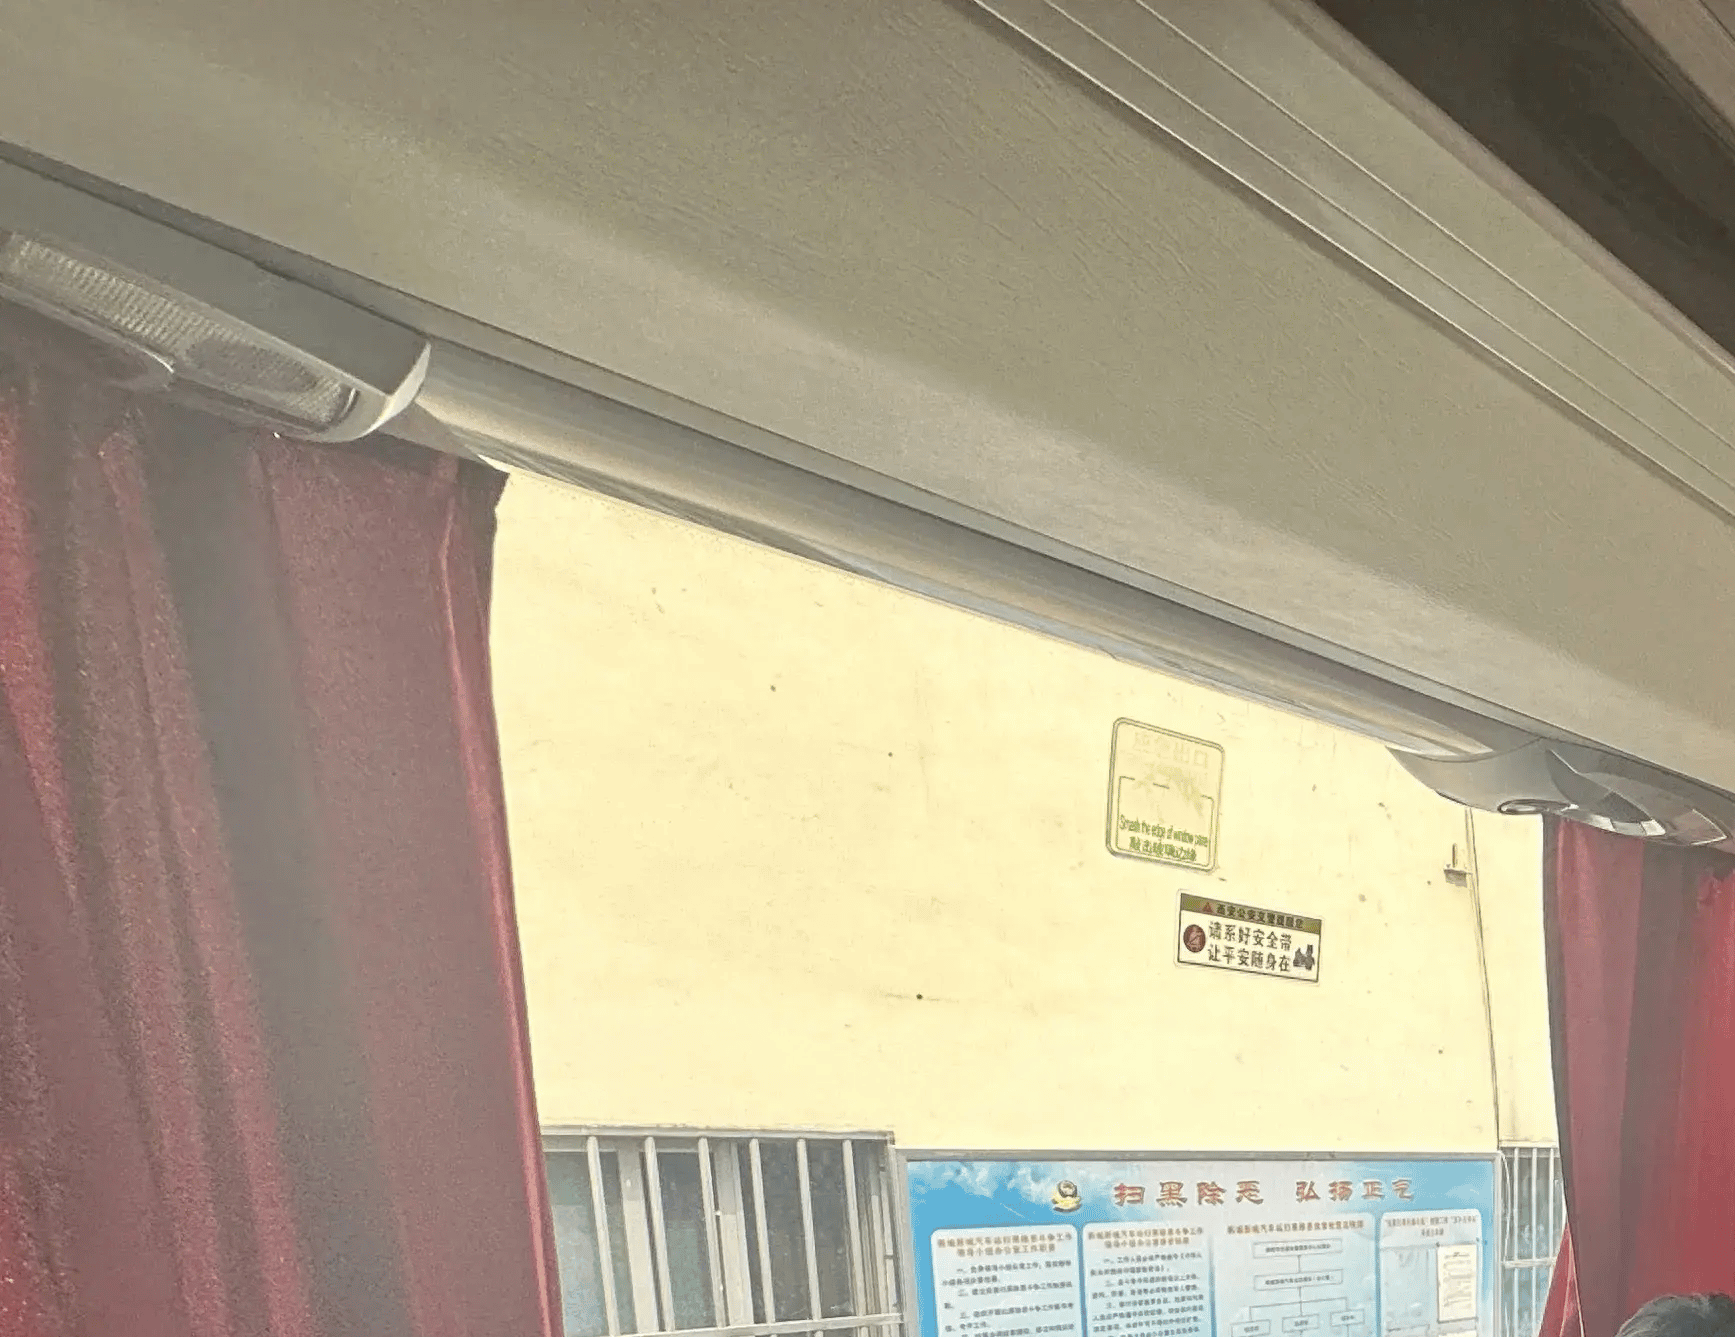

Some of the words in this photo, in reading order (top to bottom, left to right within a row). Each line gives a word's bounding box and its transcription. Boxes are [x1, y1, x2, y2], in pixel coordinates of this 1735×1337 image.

[1208, 920, 1292, 951] 请系好安全带
[1207, 943, 1291, 972] 让平安随身在
[1113, 1179, 1265, 1208] 扫黑除恶
[1295, 1178, 1415, 1202] 弘扬正气
